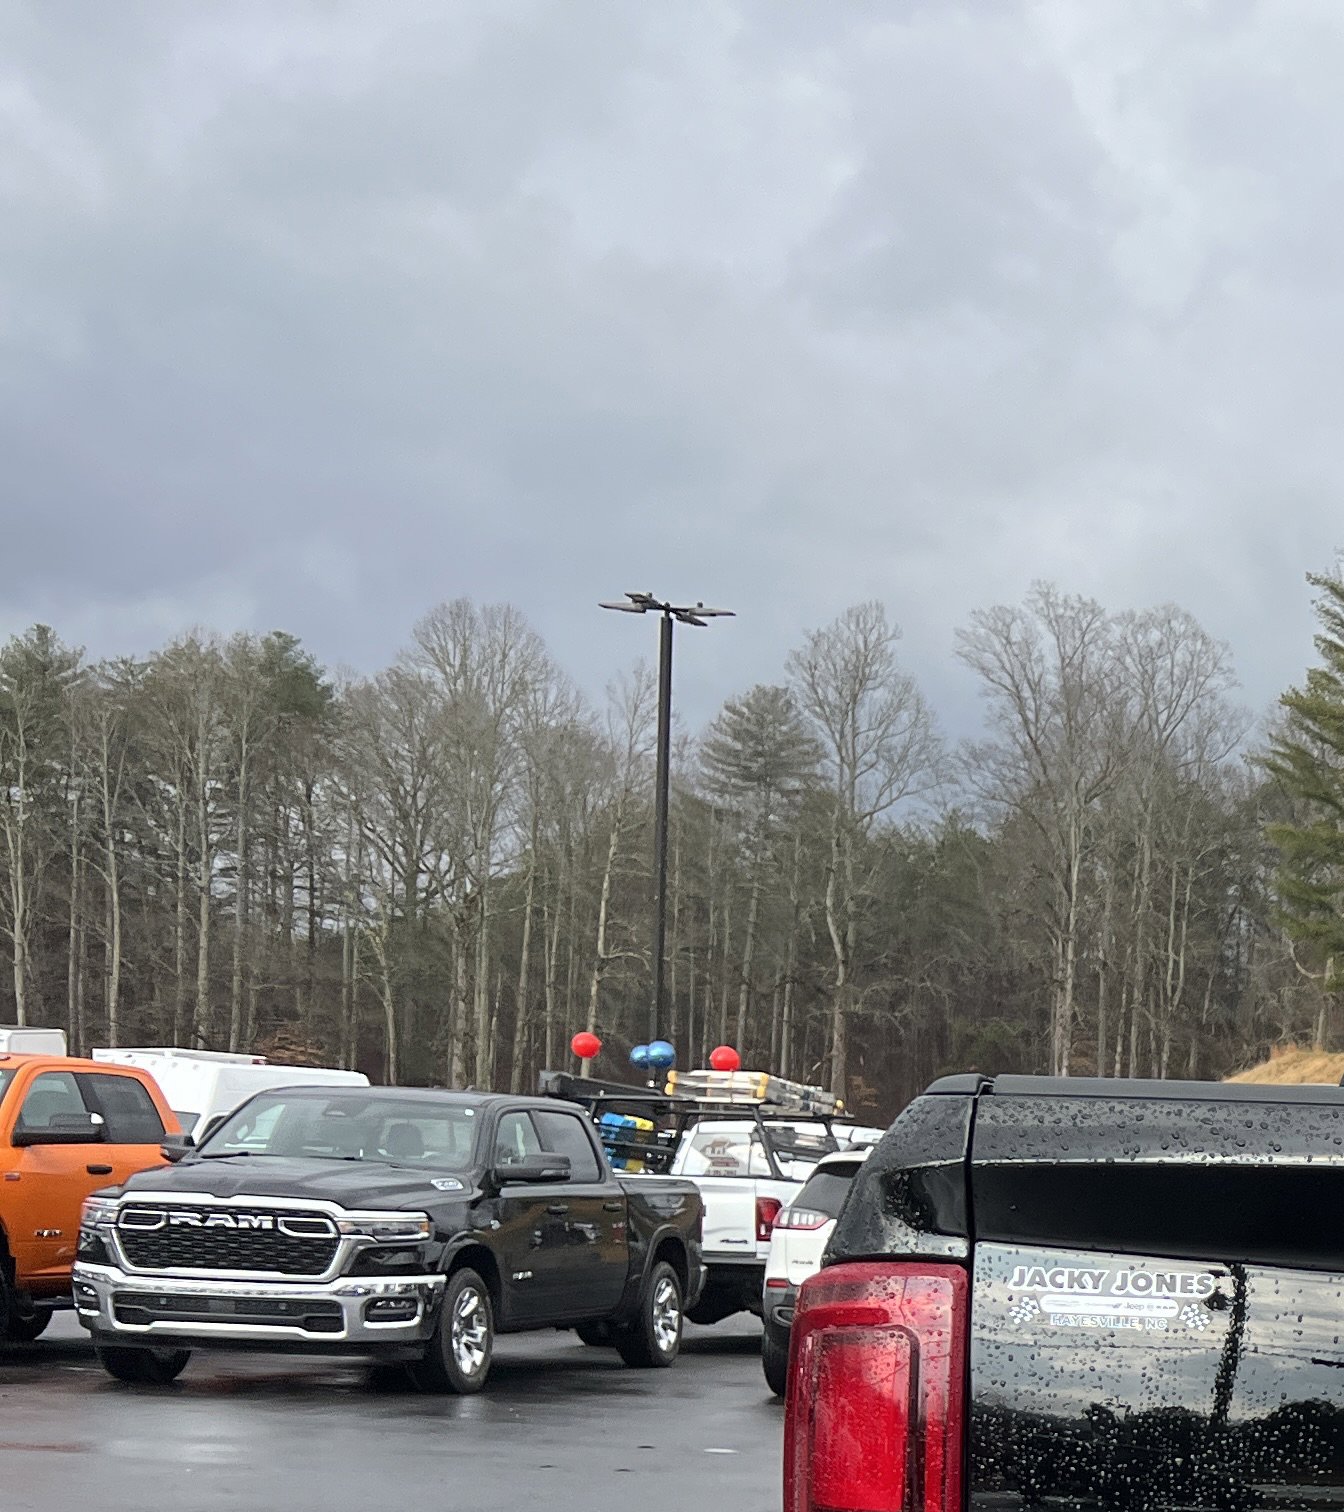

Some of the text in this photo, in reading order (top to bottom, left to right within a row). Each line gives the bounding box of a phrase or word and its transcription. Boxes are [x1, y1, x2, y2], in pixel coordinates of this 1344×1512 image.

[168, 1211, 274, 1229] RAM
[1007, 1265, 1217, 1299] JACKY JONES
[1145, 1317, 1169, 1330] NC
